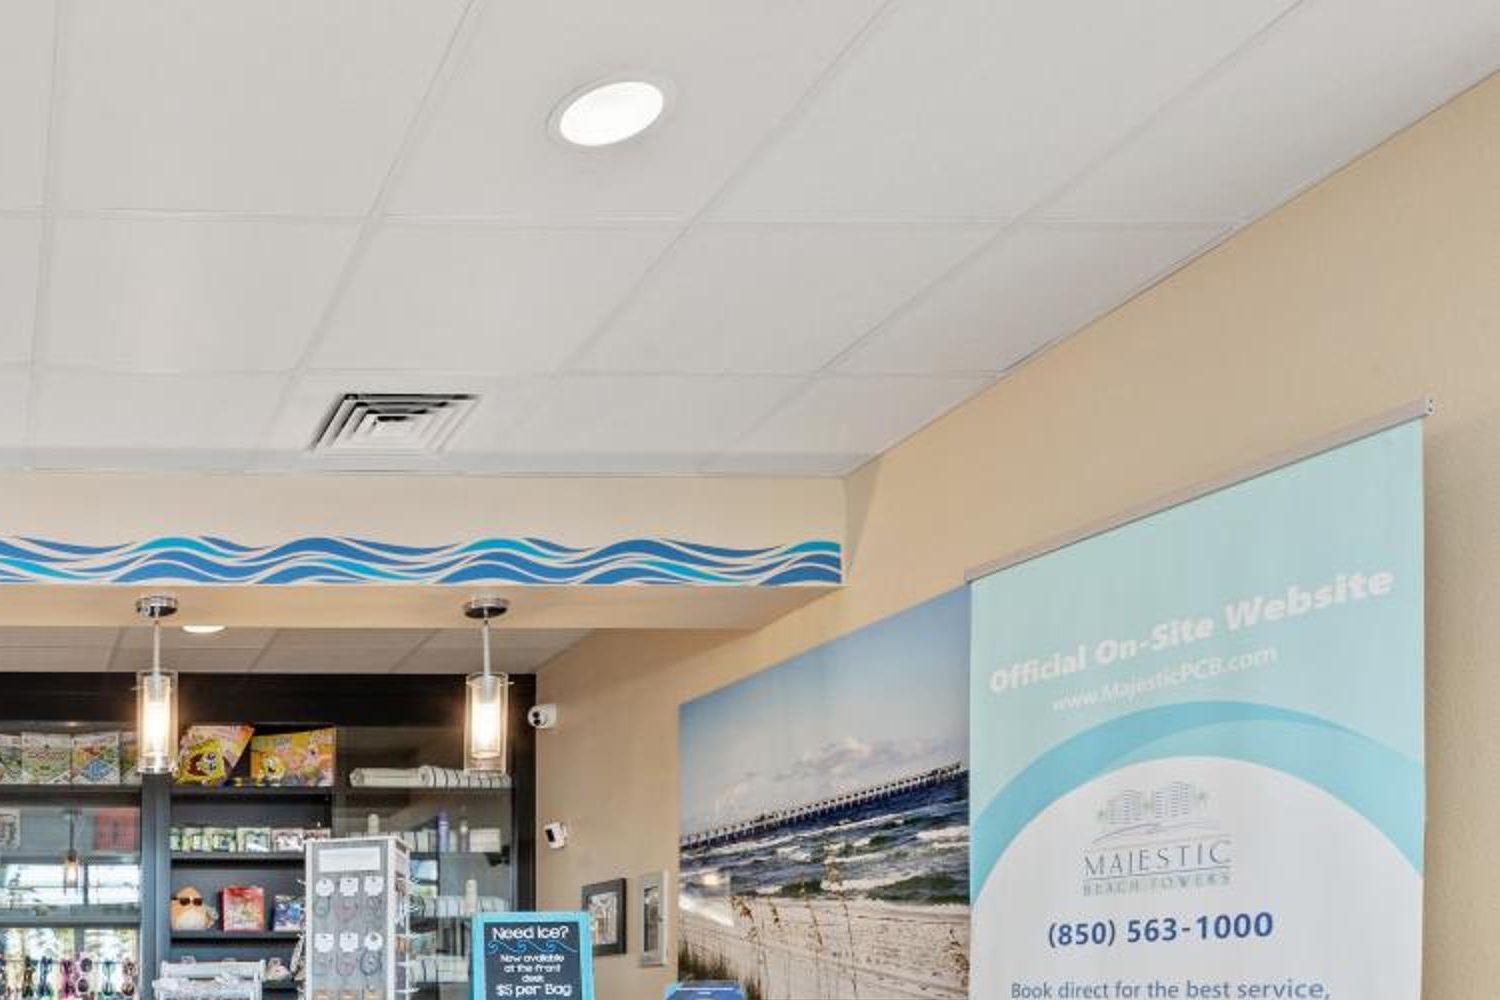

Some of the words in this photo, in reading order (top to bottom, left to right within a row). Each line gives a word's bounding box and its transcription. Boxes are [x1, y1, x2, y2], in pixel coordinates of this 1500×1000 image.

[989, 645, 1086, 692] Official
[1095, 617, 1214, 664] On-Site
[1225, 571, 1394, 631] Website
[1053, 646, 1278, 711] www.MajesticPCB.com
[1083, 840, 1233, 877] MAJESTIC
[1083, 879, 1140, 896] BEACH
[1150, 873, 1231, 890] TOWERS
[492, 926, 534, 940] Need
[538, 926, 569, 939] Ice?
[1049, 919, 1116, 948] (850)
[1127, 912, 1274, 943] 563-1000
[500, 954, 522, 962] Now
[523, 954, 565, 963] available
[504, 964, 515, 973] at
[517, 964, 533, 973] the
[535, 964, 561, 973] front
[496, 984, 513, 997] $5
[515, 984, 541, 998] per
[545, 984, 573, 997] Bag
[1011, 983, 1052, 999] Book
[1058, 982, 1109, 999] direct
[1115, 981, 1140, 998] for
[1147, 981, 1179, 999] the
[1186, 980, 1230, 999] best
[1237, 979, 1331, 1000] service,
